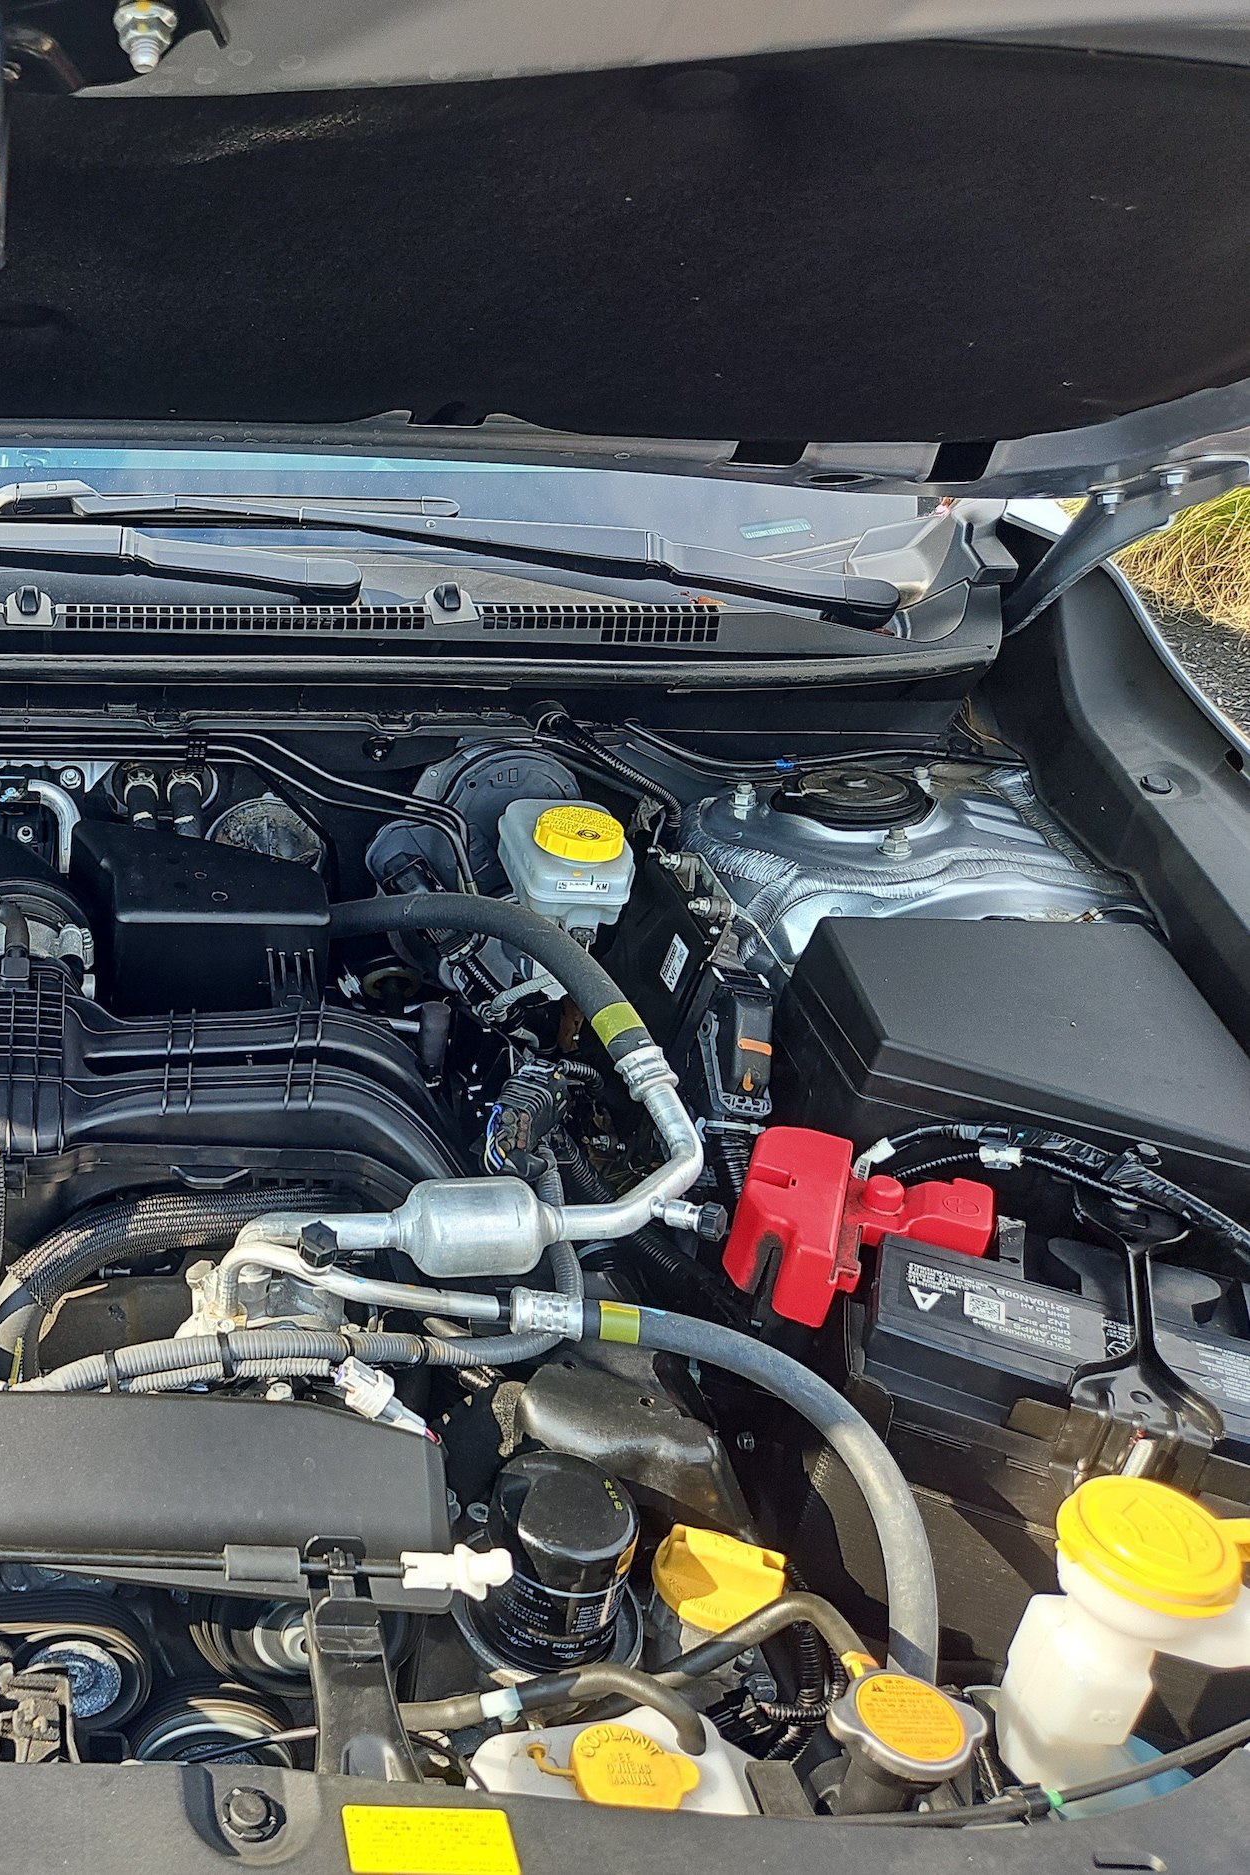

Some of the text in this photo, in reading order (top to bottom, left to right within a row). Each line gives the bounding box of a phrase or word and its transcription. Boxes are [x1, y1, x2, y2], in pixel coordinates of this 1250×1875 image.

[595, 882, 608, 890] KM
[908, 1285, 942, 1312] A
[996, 1288, 1070, 1314] 82110AN00B
[1020, 1302, 1036, 1310] AH
[1047, 1310, 1070, 1320] 20HR
[1047, 1317, 1070, 1329] LN2
[972, 1318, 1072, 1350] COLD CRANKING AMPS
[1012, 1322, 1071, 1344] 620 AMPS
[1018, 1316, 1071, 1336] GROUP SIZE
[511, 1626, 548, 1646] TOKYO
[577, 1726, 664, 1758] COOLANT
[611, 1774, 656, 1786] MANUAL
